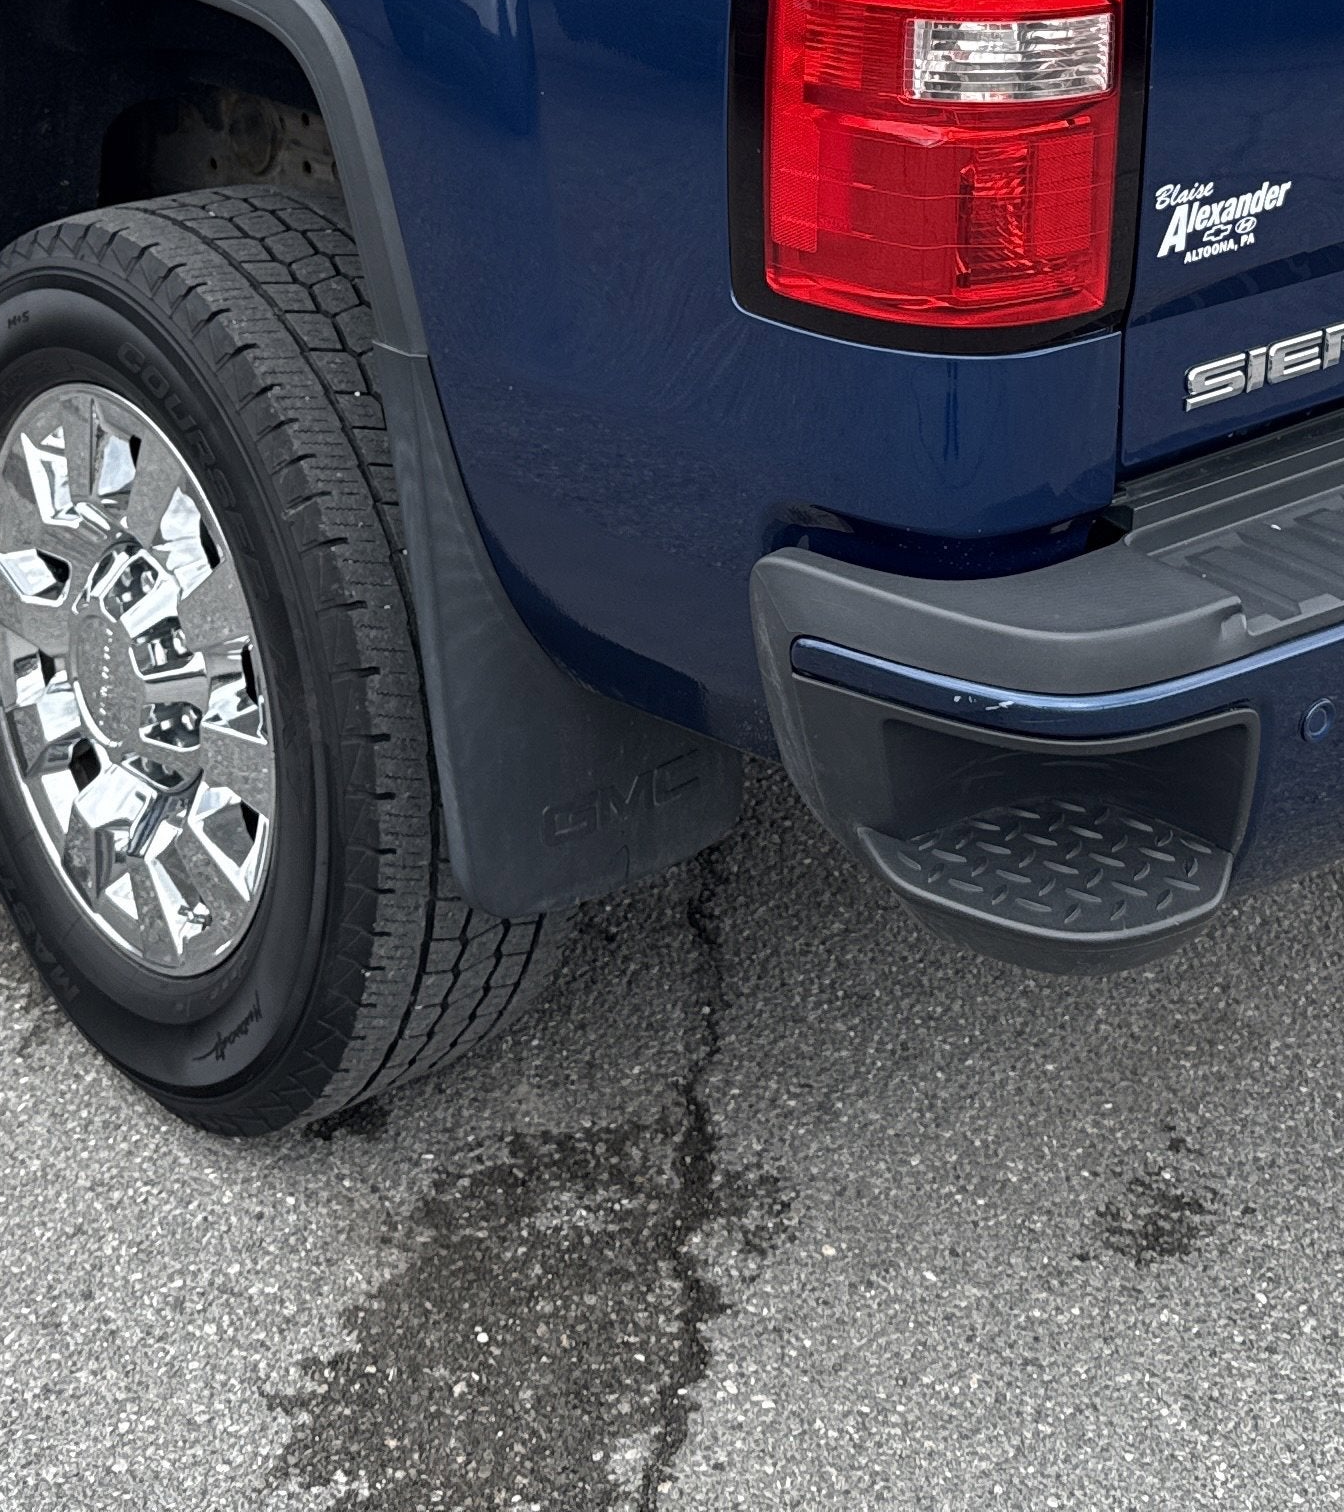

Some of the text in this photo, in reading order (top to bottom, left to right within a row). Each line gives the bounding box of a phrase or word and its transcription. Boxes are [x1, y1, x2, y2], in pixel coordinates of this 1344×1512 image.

[1155, 181, 1215, 210] Blaise
[1156, 180, 1293, 258] Alexander
[1183, 232, 1255, 264] ALTOONA, PA
[542, 747, 701, 846] GMC
